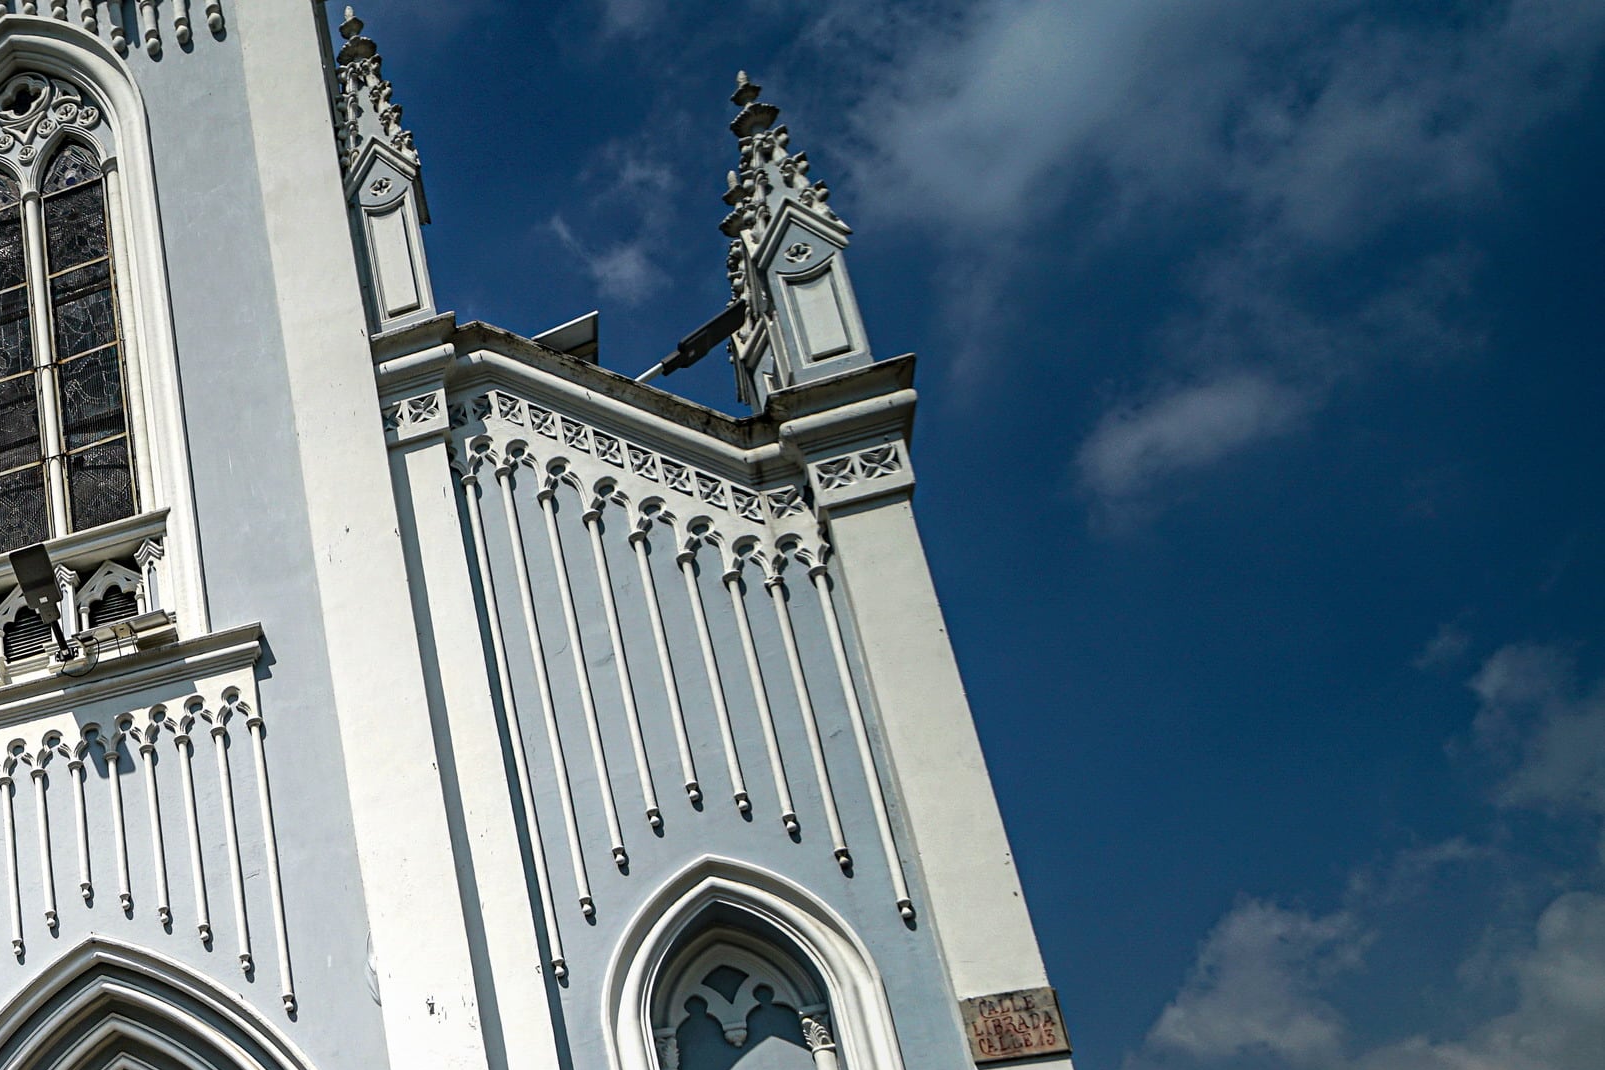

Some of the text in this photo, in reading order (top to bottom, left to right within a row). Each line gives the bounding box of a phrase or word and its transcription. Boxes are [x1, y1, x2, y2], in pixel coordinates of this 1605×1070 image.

[978, 994, 1035, 1018] CALLE
[972, 1011, 1055, 1036] LIBRADA
[978, 1032, 1033, 1056] CALLE
